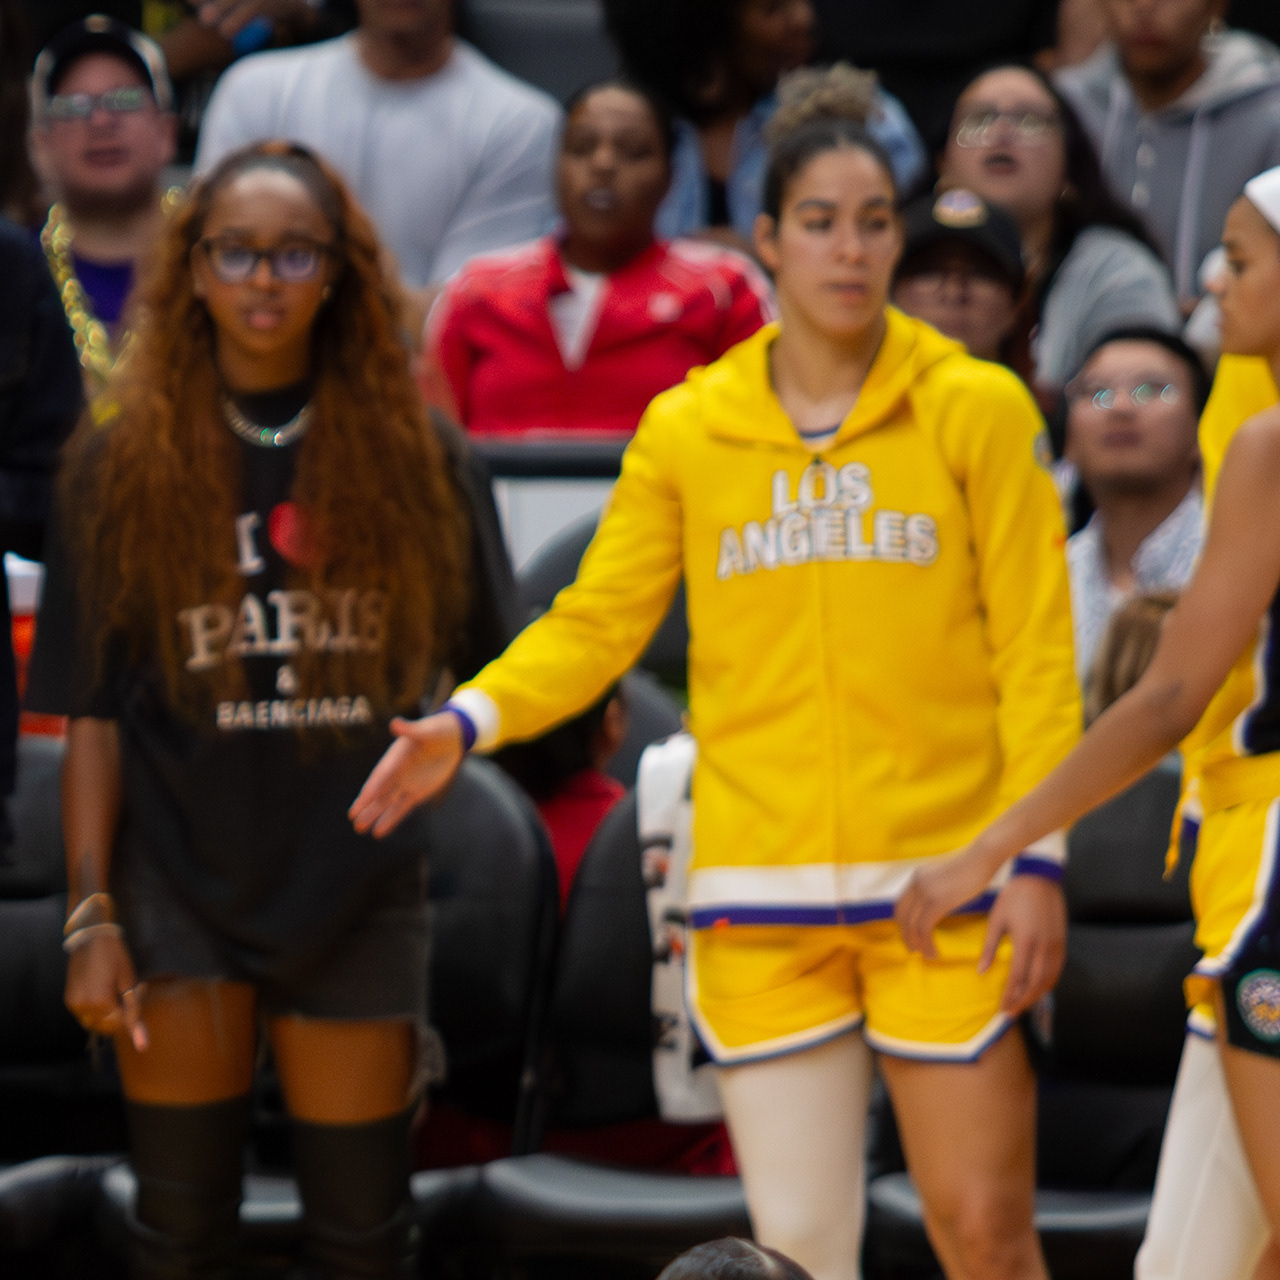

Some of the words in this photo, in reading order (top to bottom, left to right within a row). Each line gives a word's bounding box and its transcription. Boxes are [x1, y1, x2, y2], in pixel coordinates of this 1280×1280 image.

[771, 460, 874, 517] LOS
[236, 511, 265, 576] I
[716, 508, 939, 581] ANGELES
